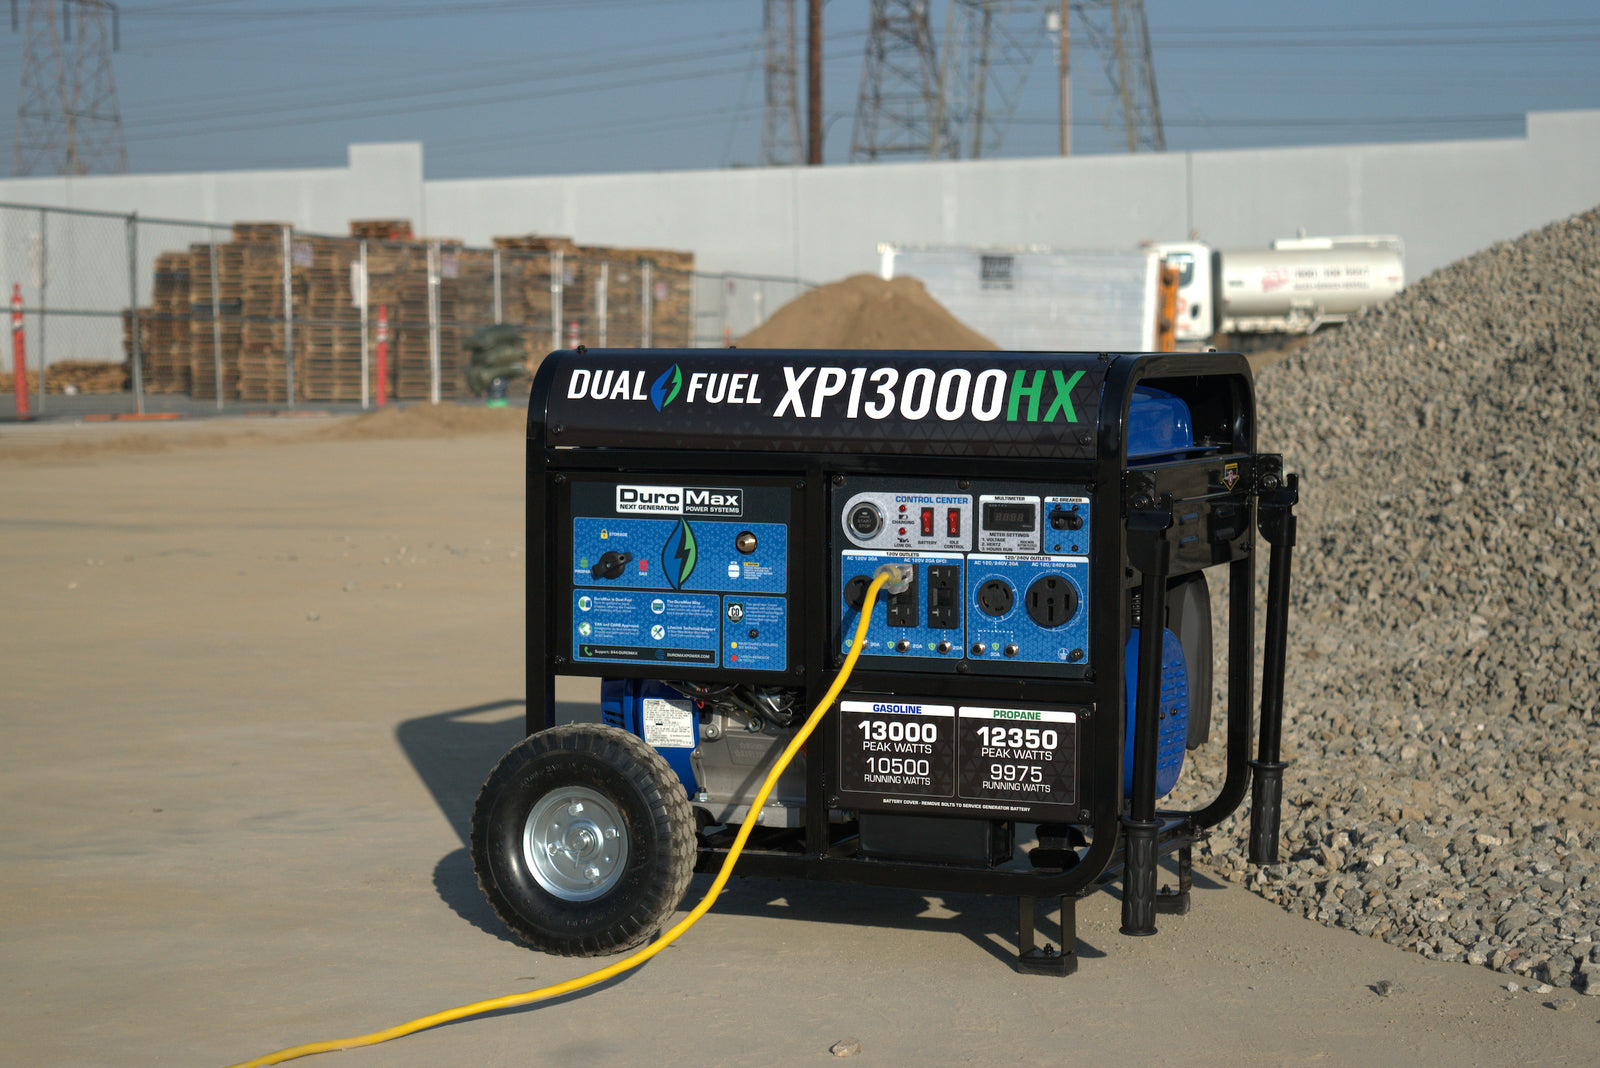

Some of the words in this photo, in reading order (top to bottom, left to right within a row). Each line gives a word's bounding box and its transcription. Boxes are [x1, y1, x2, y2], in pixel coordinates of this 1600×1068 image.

[567, 369, 648, 400] DUAL
[686, 372, 762, 404] FUEL
[772, 366, 1086, 423] XP13000HX
[620, 488, 680, 504] Duro
[686, 490, 738, 506] Max
[731, 608, 739, 616] CO
[873, 704, 922, 714] GASOLINE
[993, 710, 1041, 720] PROPANE
[858, 720, 937, 743] 13000
[977, 726, 1057, 749] 12350
[863, 741, 891, 752] PEAK
[894, 743, 932, 754] WATTS
[982, 747, 1011, 758] PEAK
[1014, 749, 1052, 761] WATTS
[866, 757, 929, 776] 10500
[990, 764, 1042, 782] 9975
[864, 774, 901, 784] RUNNING
[903, 776, 931, 786] WATTS
[982, 781, 1020, 791] RUNNING
[1022, 783, 1051, 793] WATTS
